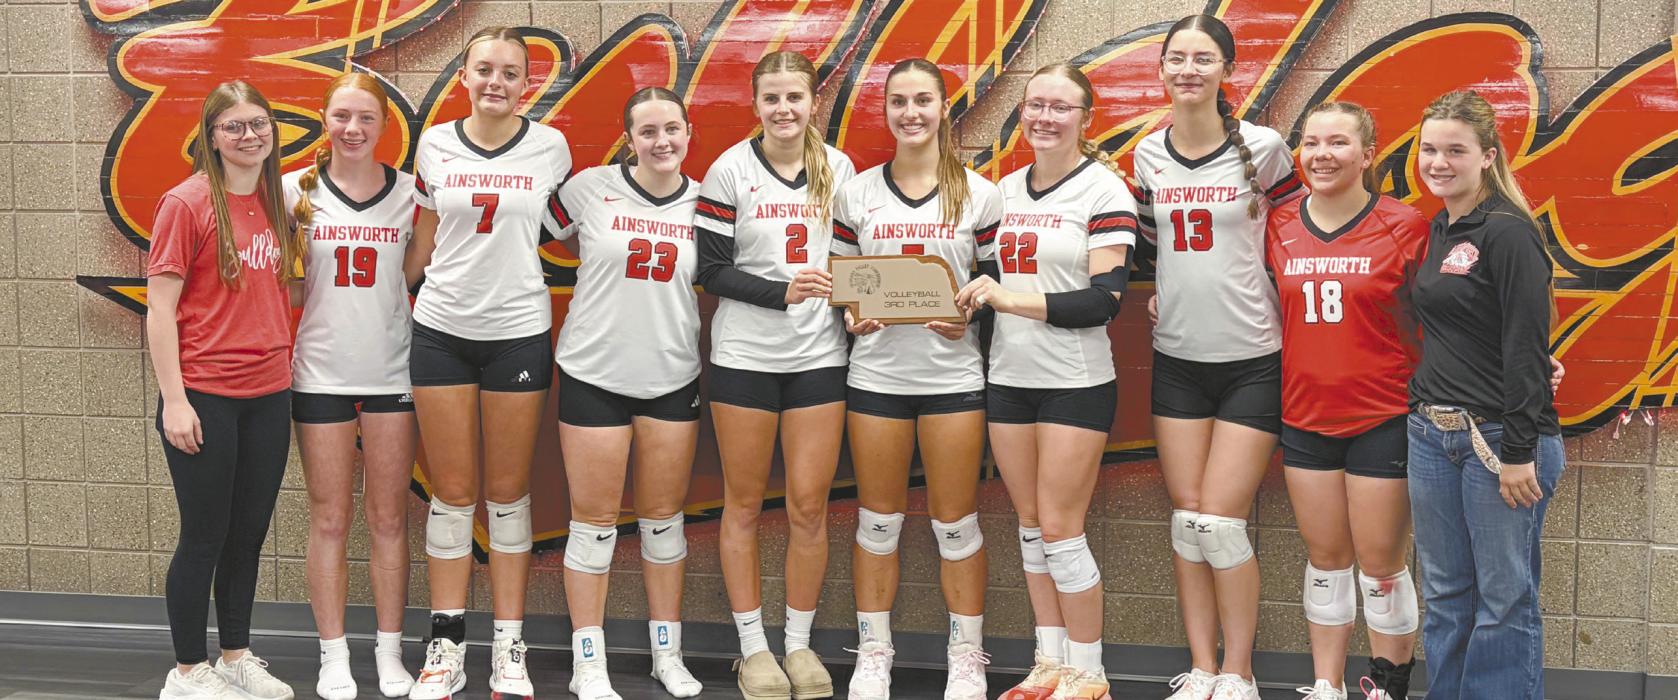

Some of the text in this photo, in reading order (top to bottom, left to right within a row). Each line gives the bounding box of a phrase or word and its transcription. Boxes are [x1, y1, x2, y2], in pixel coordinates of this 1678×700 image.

[444, 173, 534, 191] AINSWORTH
[1154, 186, 1238, 204] AINSWORTH
[472, 193, 500, 234] 7
[756, 203, 832, 219] AINSWORT
[1000, 212, 1062, 229] NSWORTH
[313, 225, 400, 243] AINSWORTH
[611, 215, 696, 242] AINSWORTH
[872, 222, 956, 241] AINSWORTH
[1170, 208, 1214, 252] 13
[785, 223, 808, 264] 2
[999, 231, 1039, 275] 22
[334, 245, 378, 288] 19
[625, 237, 679, 283] 23
[1283, 256, 1372, 276] AINSWORTH
[883, 290, 941, 298] VOLLEYBALL
[908, 300, 941, 308] PLACE
[1301, 279, 1344, 324] 18
